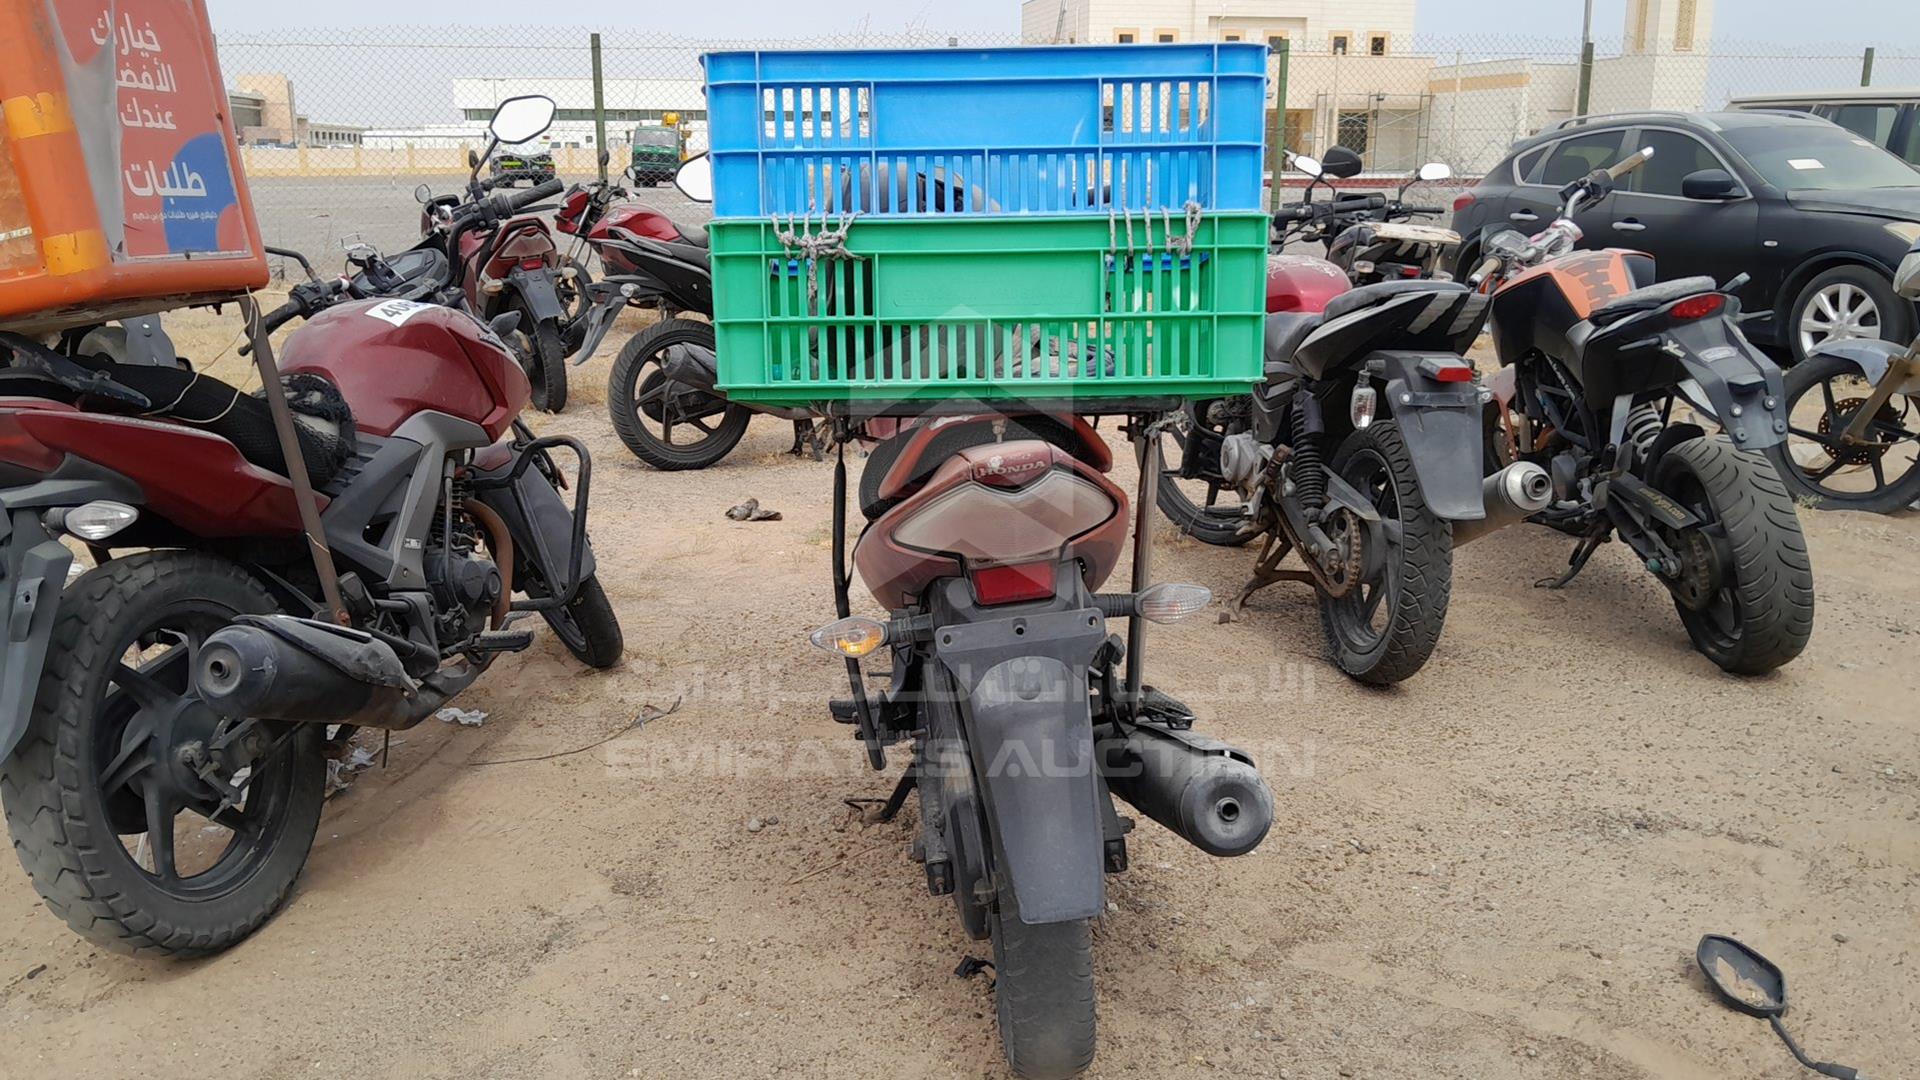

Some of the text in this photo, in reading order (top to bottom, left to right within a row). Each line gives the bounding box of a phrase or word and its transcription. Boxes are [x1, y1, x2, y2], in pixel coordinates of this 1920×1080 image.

[116, 57, 177, 93] الأفض
[120, 96, 177, 130] عندك
[124, 160, 208, 204] طلبات
[979, 460, 1046, 477] HONDA
